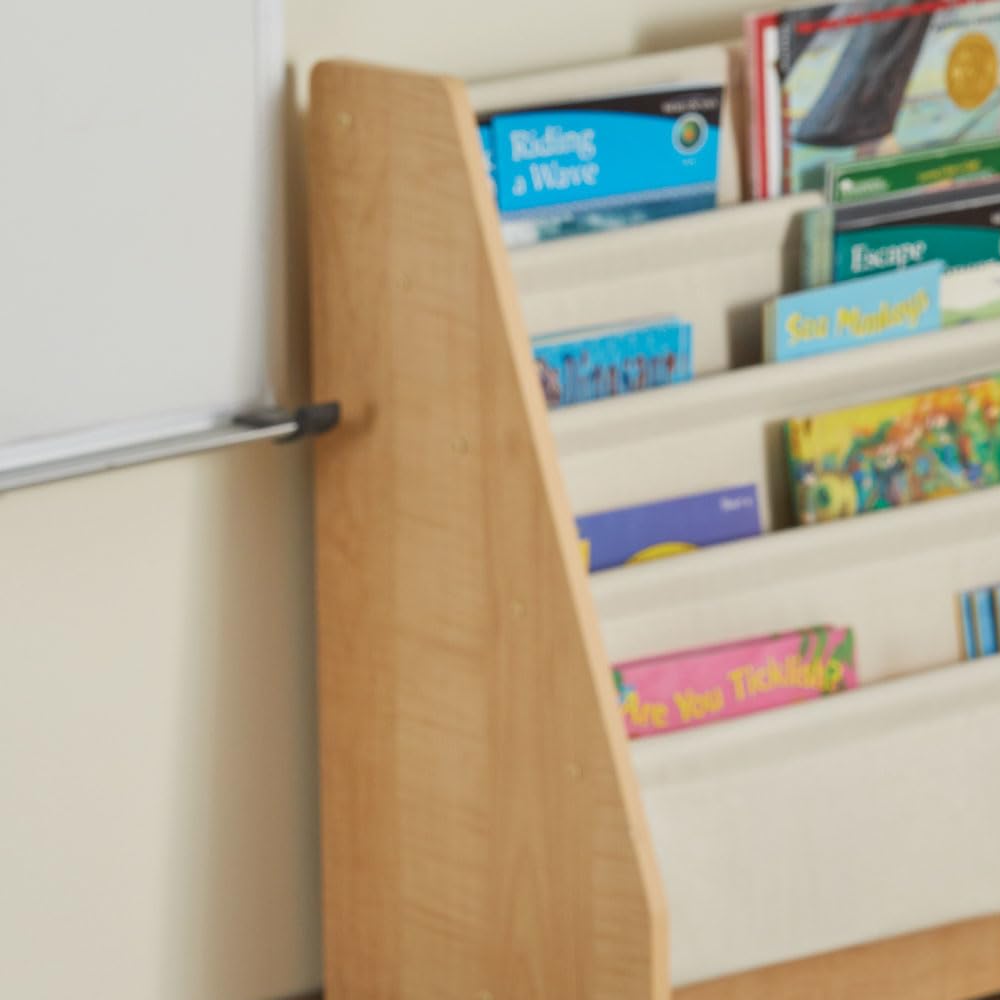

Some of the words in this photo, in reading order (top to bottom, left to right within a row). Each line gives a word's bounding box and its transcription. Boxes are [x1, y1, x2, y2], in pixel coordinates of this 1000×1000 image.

[510, 125, 597, 162] Riding
[512, 174, 527, 196] a
[529, 160, 600, 191] Wave
[851, 240, 927, 272] Escape
[786, 311, 829, 346] Sea
[622, 691, 669, 728] Are
[673, 688, 724, 721] You
